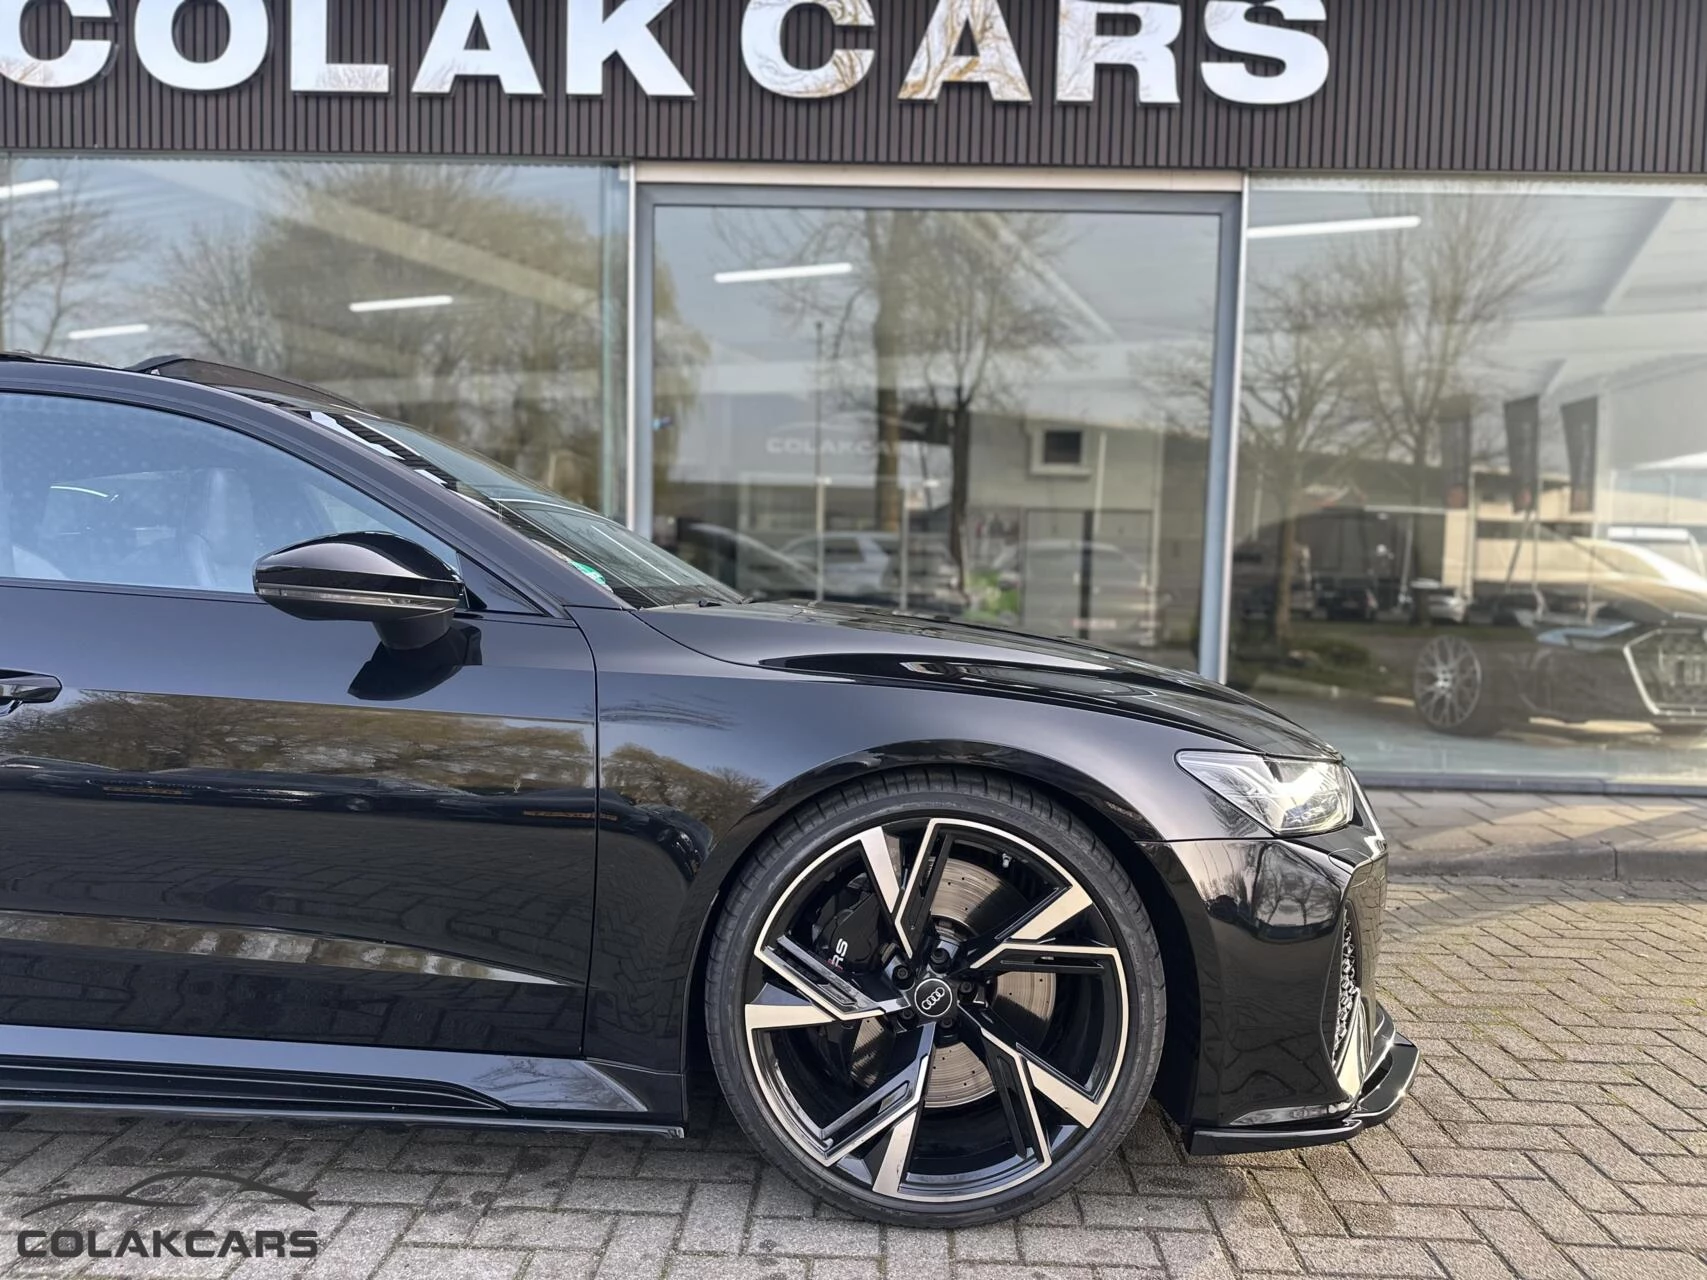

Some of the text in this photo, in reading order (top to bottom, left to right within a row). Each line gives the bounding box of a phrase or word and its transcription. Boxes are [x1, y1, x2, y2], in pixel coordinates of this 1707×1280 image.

[0, 0, 1329, 105] COLAK CARS
[831, 938, 848, 968] RS
